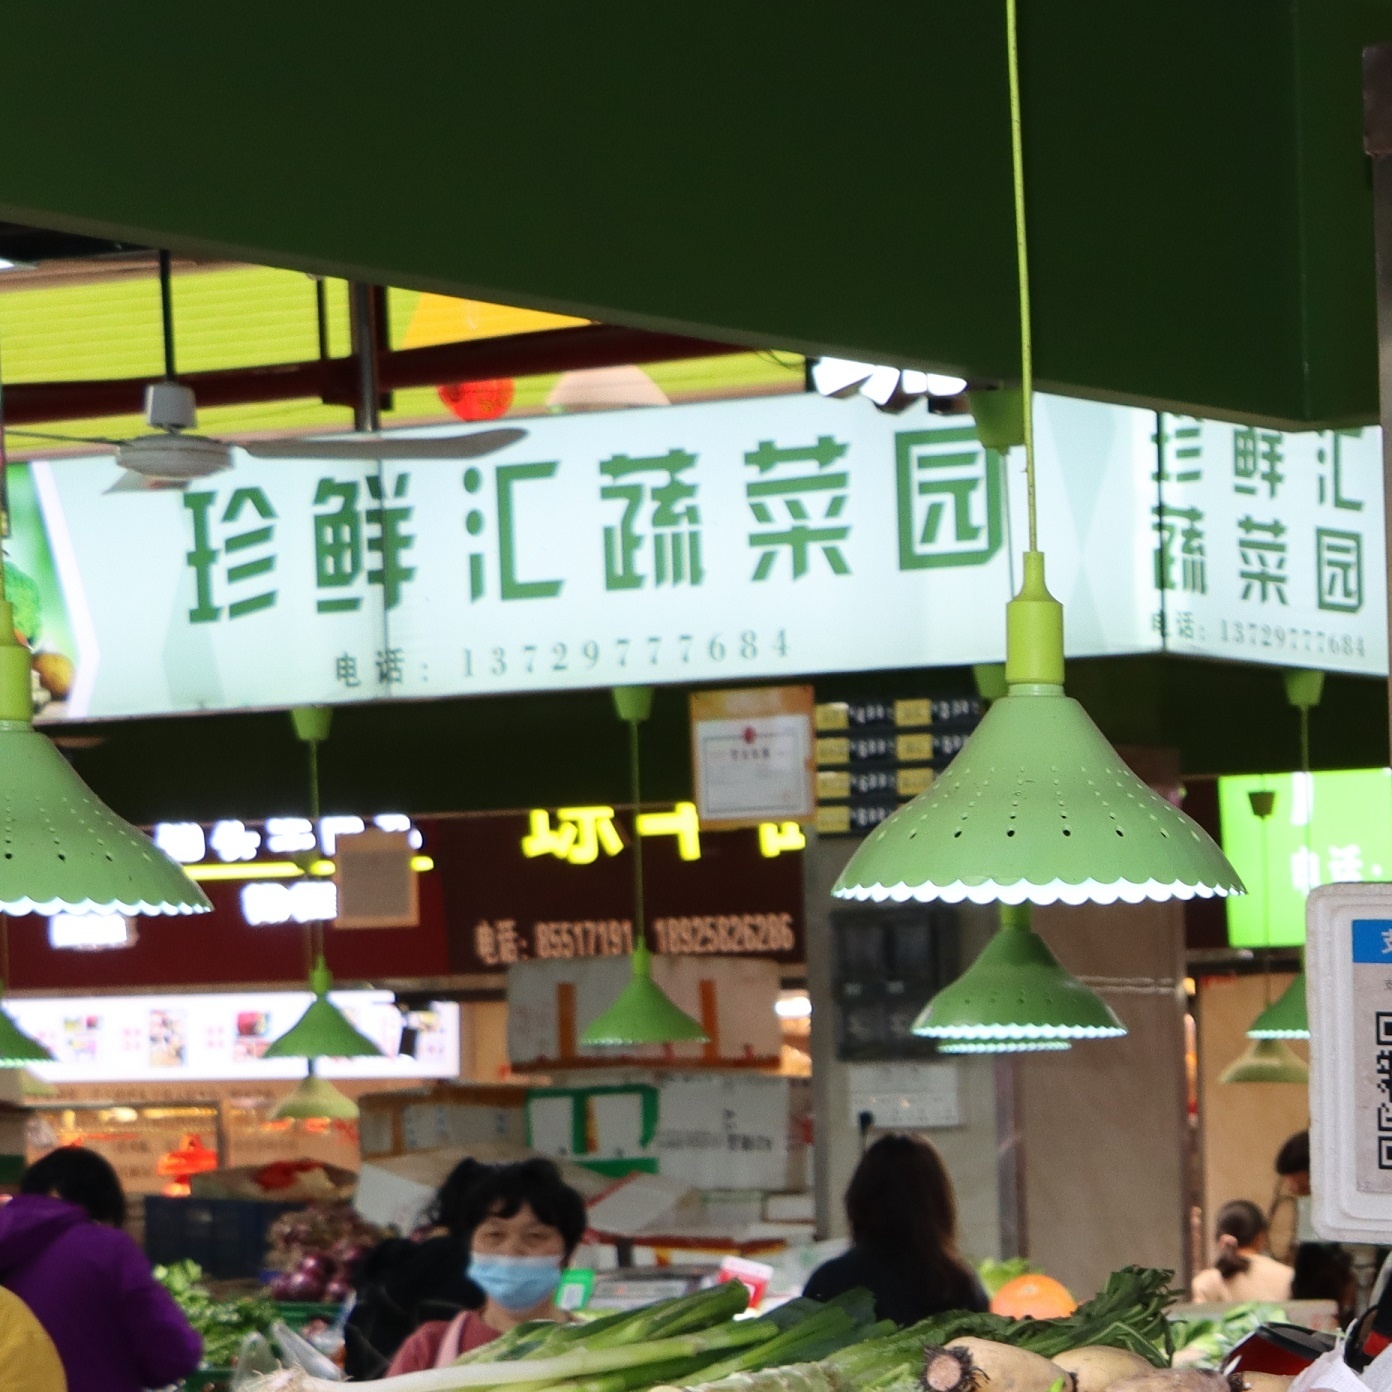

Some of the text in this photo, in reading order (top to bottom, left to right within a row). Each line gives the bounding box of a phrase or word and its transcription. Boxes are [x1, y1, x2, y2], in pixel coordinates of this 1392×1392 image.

[184, 425, 1003, 624] 珍鲜汇蔬菜园
[1150, 502, 1366, 613] 蔬菜园
[461, 626, 792, 679] 13729777684
[1217, 617, 1368, 658] 13729777684
